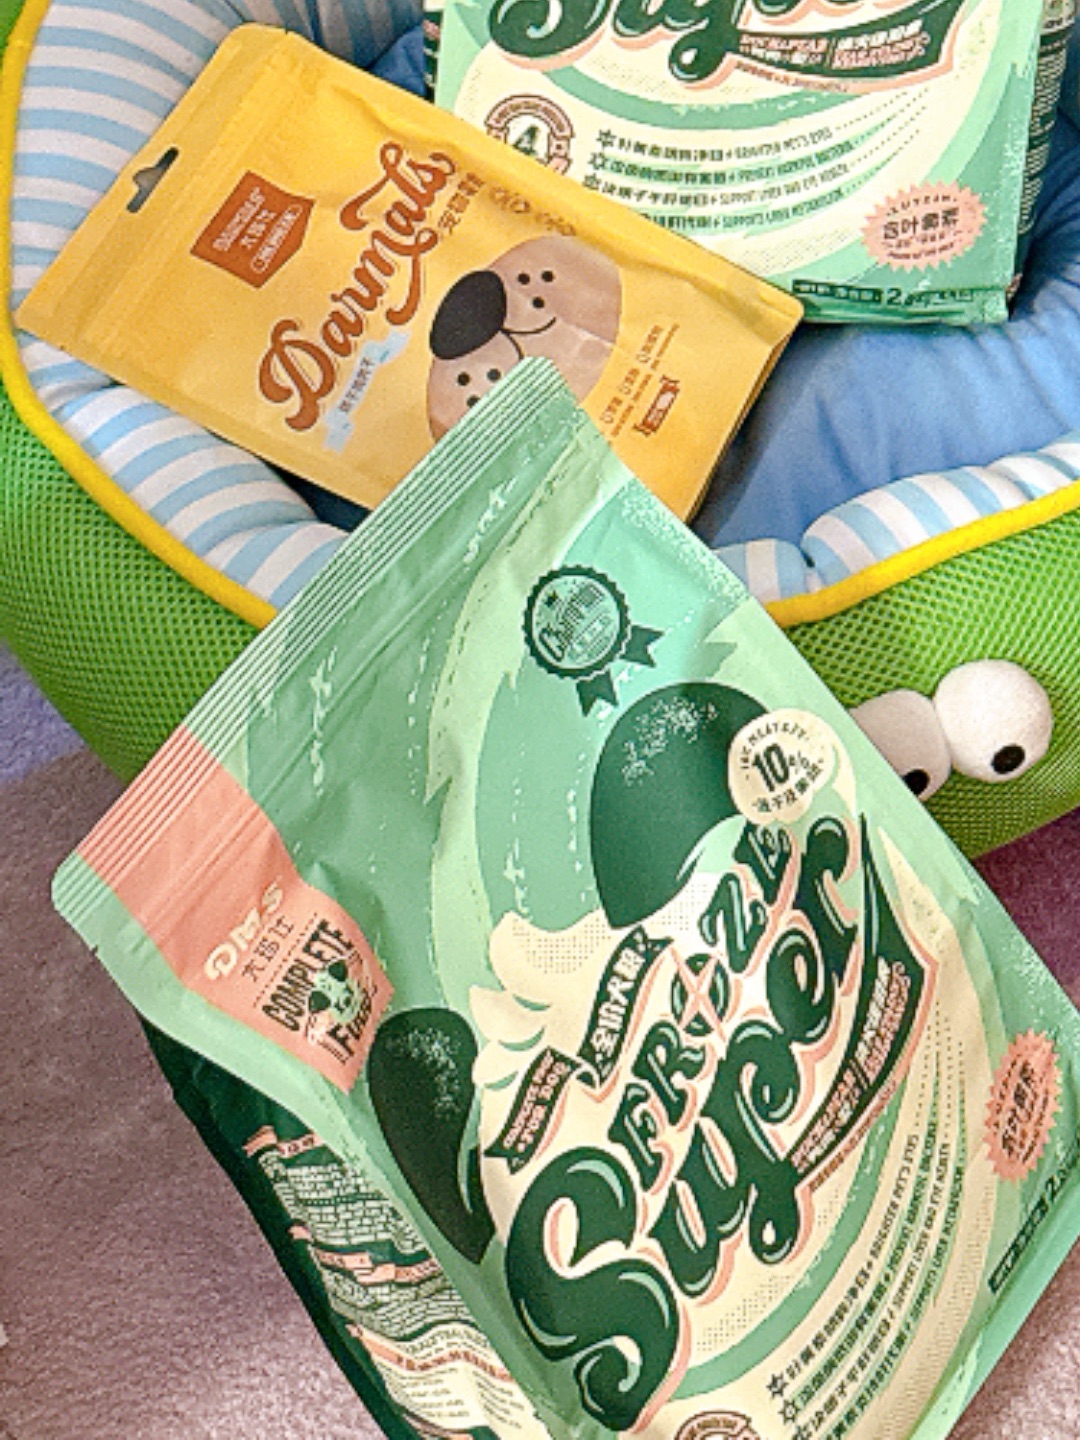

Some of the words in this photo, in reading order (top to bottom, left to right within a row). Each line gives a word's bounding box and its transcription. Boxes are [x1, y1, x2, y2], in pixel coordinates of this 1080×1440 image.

[259, 141, 455, 430] Darmals
[262, 920, 353, 1031] COMPLETE
[506, 817, 856, 1431] Super
